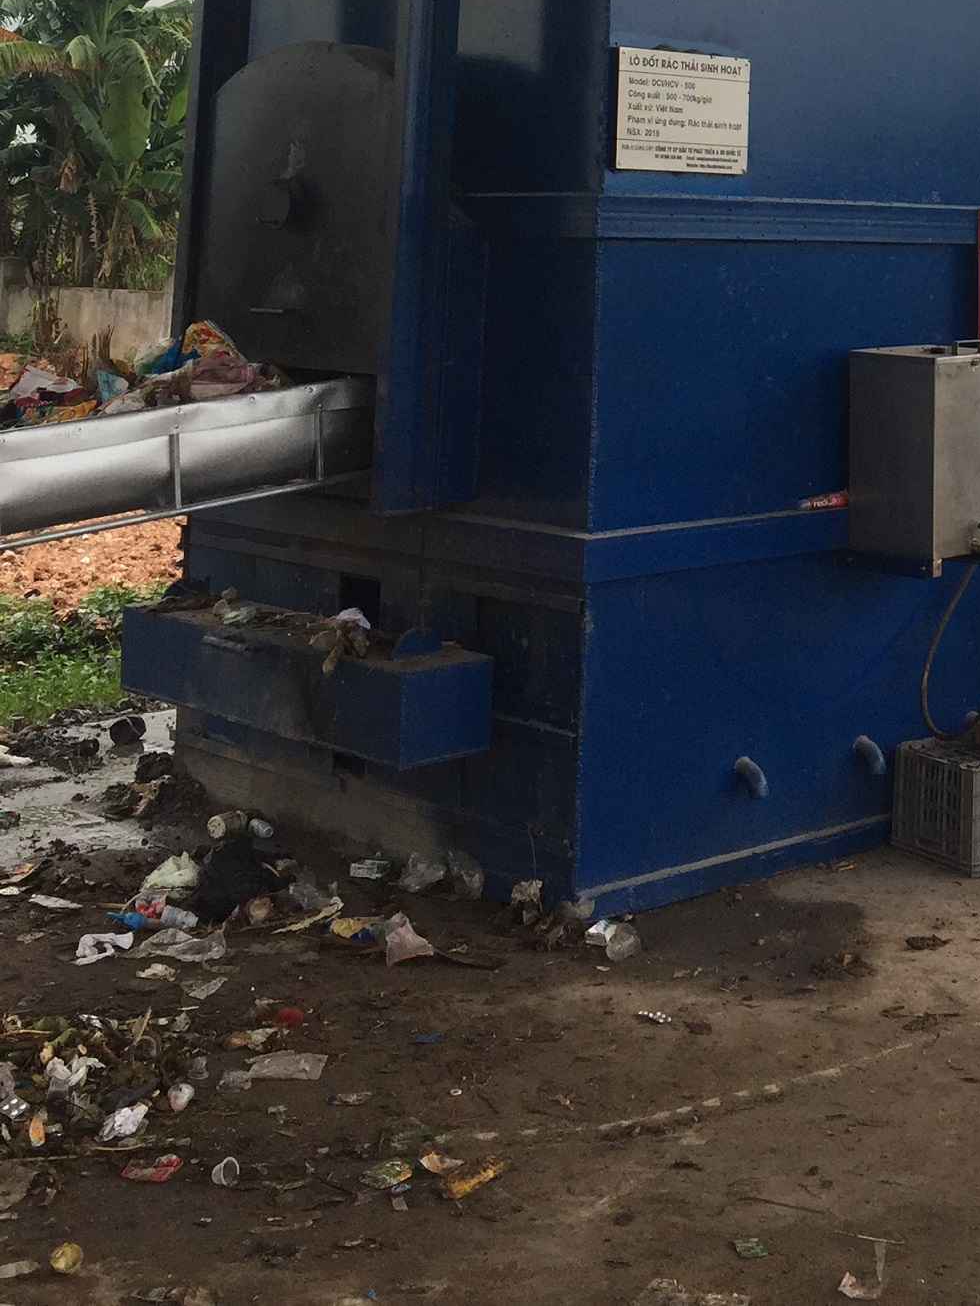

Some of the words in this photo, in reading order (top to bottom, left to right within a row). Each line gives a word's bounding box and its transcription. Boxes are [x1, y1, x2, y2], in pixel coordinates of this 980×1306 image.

[629, 54, 640, 66] LÒ
[642, 54, 659, 68] ĐỐT
[661, 57, 679, 70] RÁC
[681, 59, 699, 71] THẢI
[700, 63, 719, 74] SINH
[720, 65, 742, 78] HOẠT
[629, 77, 650, 86] Model:
[684, 81, 696, 90] 500
[628, 89, 645, 100] Công
[647, 91, 661, 99] suất
[666, 92, 677, 101] 500
[627, 102, 642, 111] Xuất
[655, 104, 668, 113] Việt
[669, 105, 683, 113] Nam
[627, 115, 645, 124] Phạm
[655, 116, 667, 127] ứng
[687, 119, 700, 128] Rác
[714, 121, 727, 129] sinh
[645, 128, 660, 137] 2019
